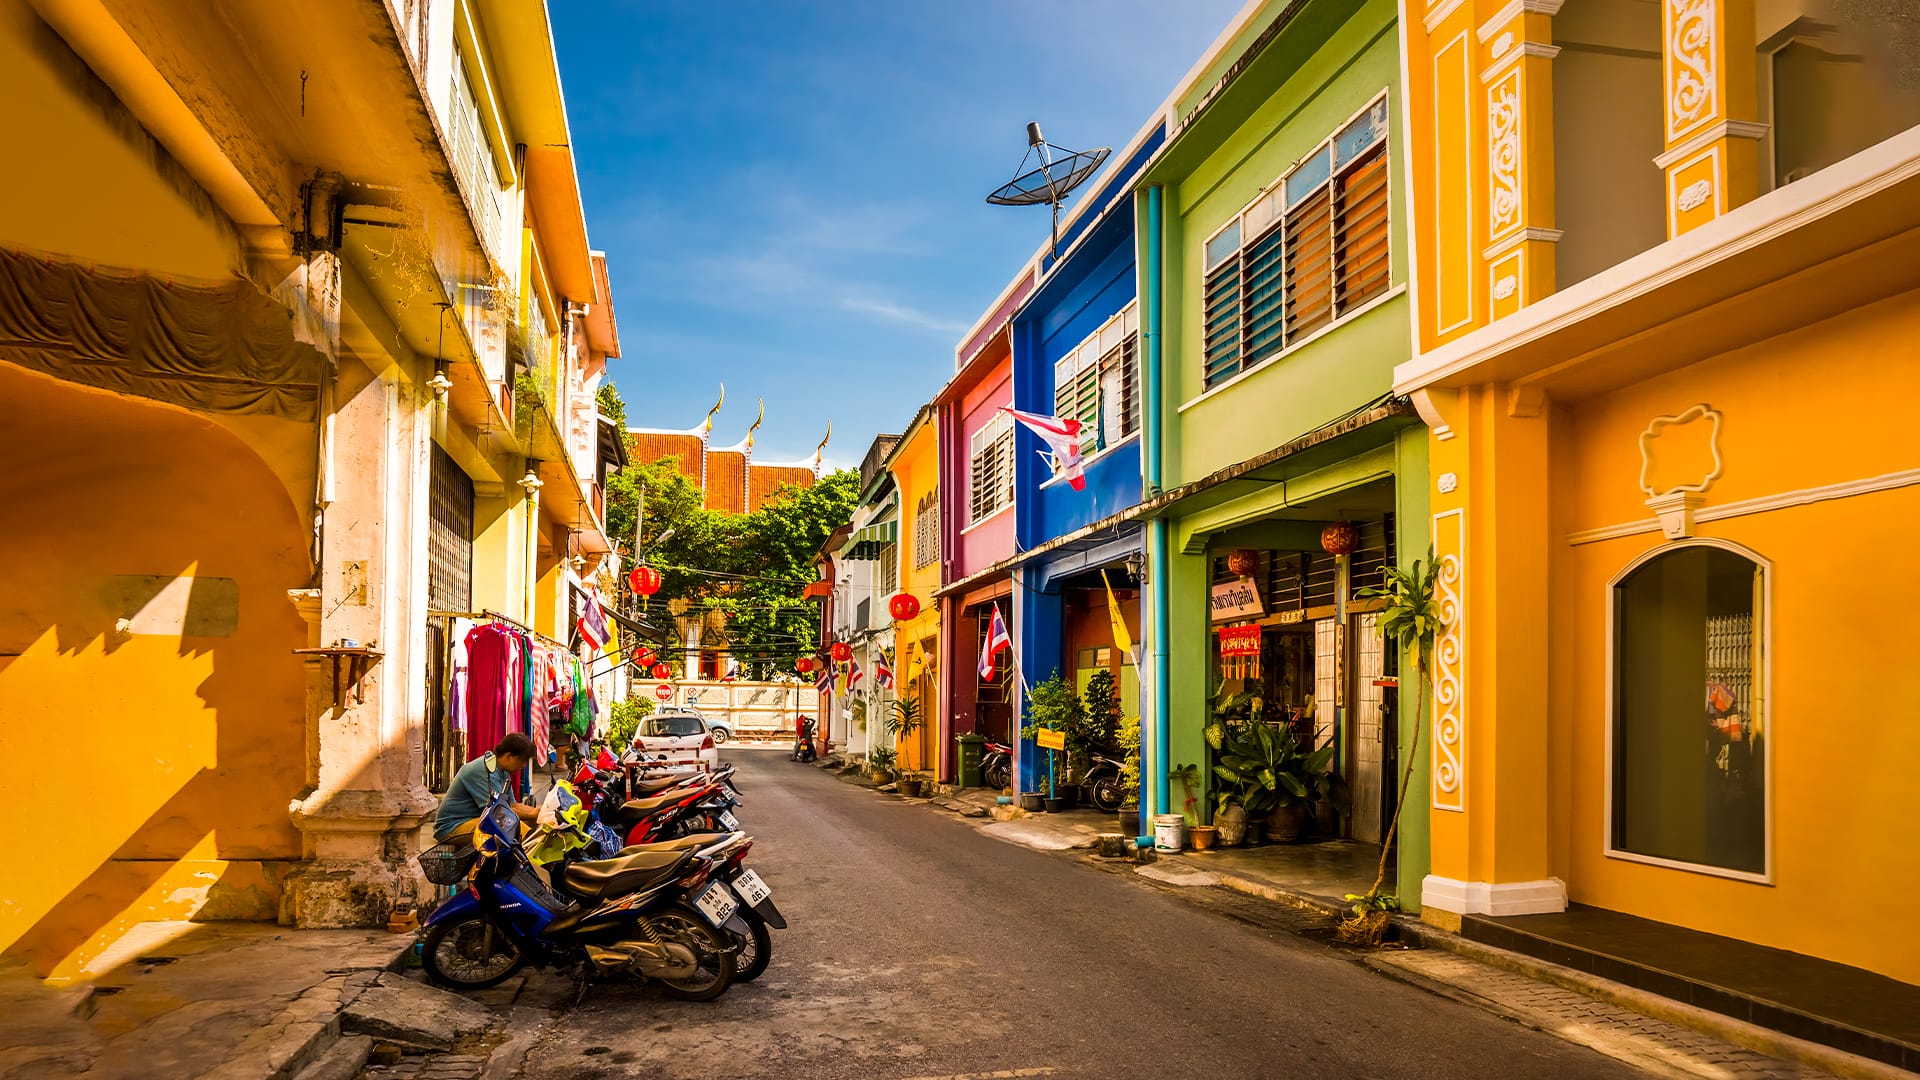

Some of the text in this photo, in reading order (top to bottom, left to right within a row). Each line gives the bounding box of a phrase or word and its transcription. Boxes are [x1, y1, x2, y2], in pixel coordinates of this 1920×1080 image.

[751, 888, 767, 902] 461
[499, 902, 522, 910] HONDA
[716, 902, 732, 920] 822
